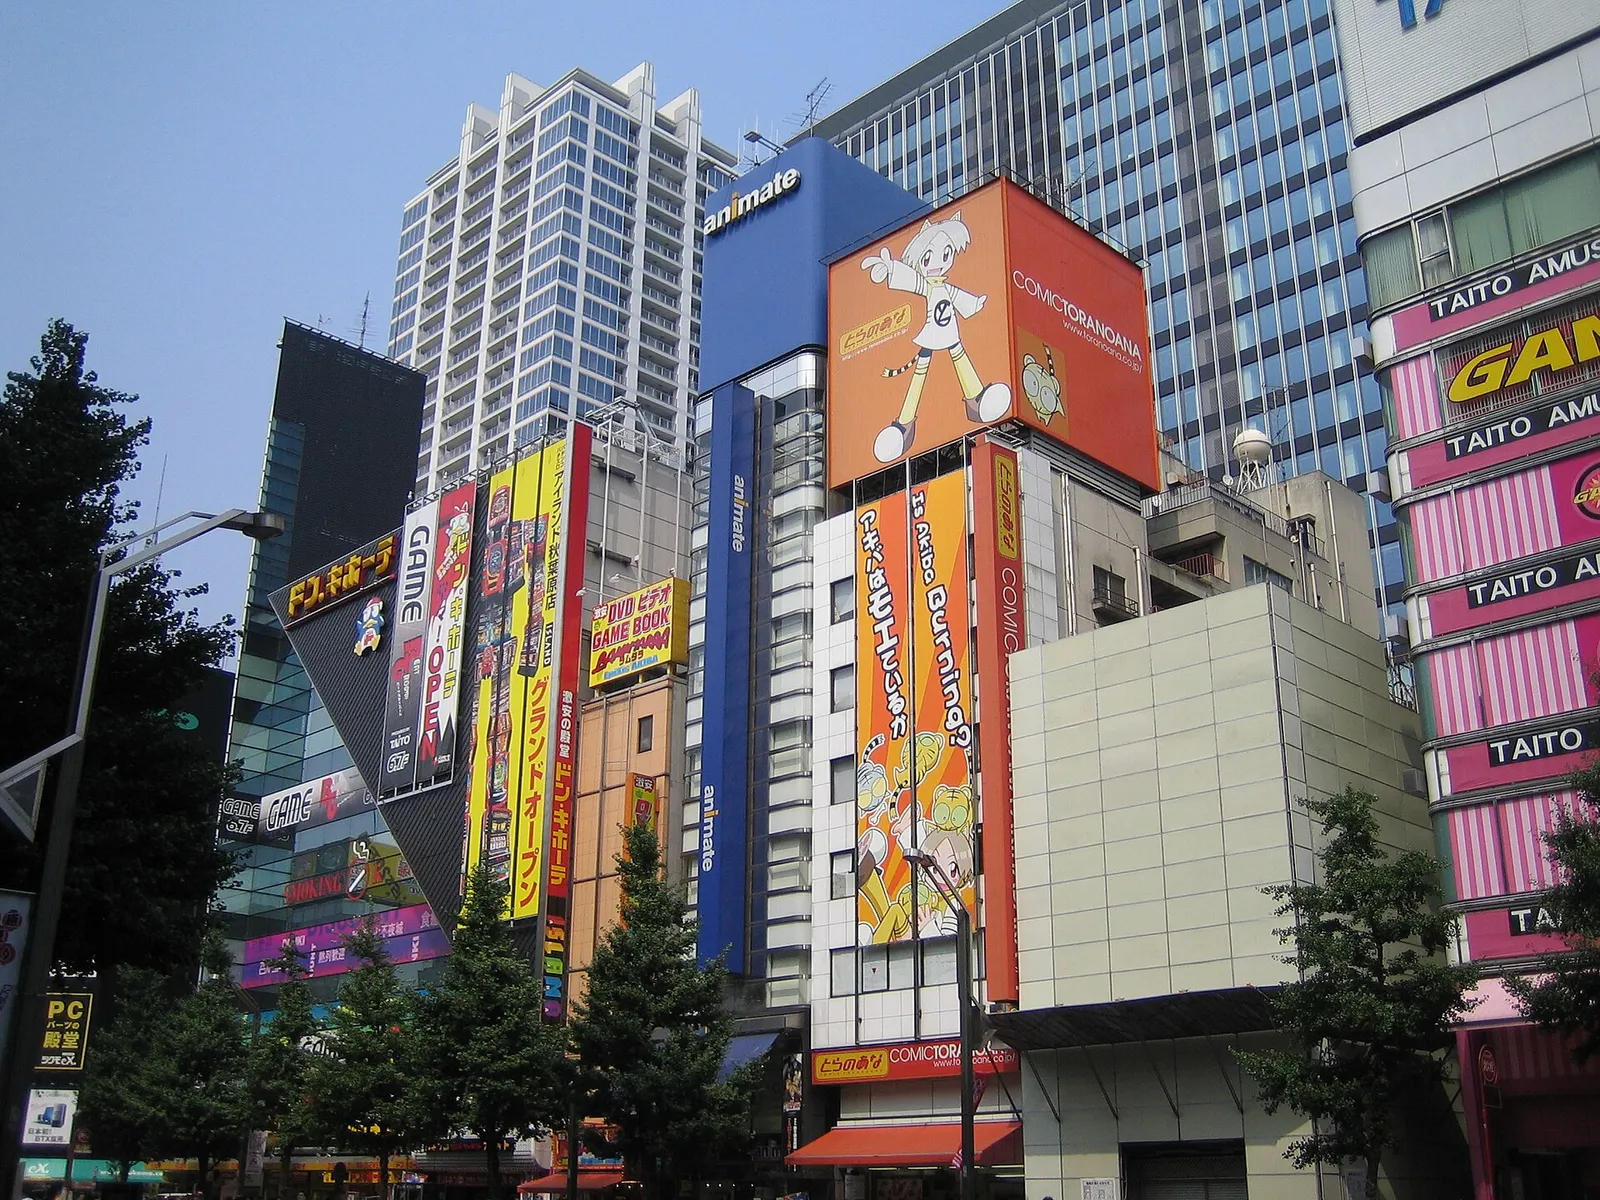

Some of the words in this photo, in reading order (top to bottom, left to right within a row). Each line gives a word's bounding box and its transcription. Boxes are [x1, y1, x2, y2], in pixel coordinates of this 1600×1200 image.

[703, 168, 799, 236] animate
[1013, 270, 1142, 361] COMICTORANOANA
[1431, 275, 1512, 317] TAITO
[1447, 416, 1531, 457] TAITO
[731, 474, 749, 553] animate
[911, 490, 926, 519] Is
[400, 525, 430, 624] GAME
[914, 521, 937, 585] Akiba
[608, 596, 636, 625] DVD
[638, 583, 672, 612] ビデオ
[1469, 566, 1557, 605] TAITO
[592, 621, 630, 652] GAME
[633, 605, 672, 637] BOOK
[858, 508, 908, 740] アキバはモエているか
[926, 583, 971, 747] Burning?
[420, 645, 444, 761] OPEN
[558, 689, 573, 758] 激安の殿堂
[1489, 727, 1583, 763] TAITO
[222, 797, 261, 819] GAME
[266, 788, 313, 831] GAME
[520, 675, 550, 908] グランドオープン
[702, 785, 720, 872] animate
[46, 1020, 80, 1030] パーツの
[47, 1000, 84, 1020] PC
[43, 1031, 80, 1049] 殿堂
[820, 1053, 883, 1073] とらのあな
